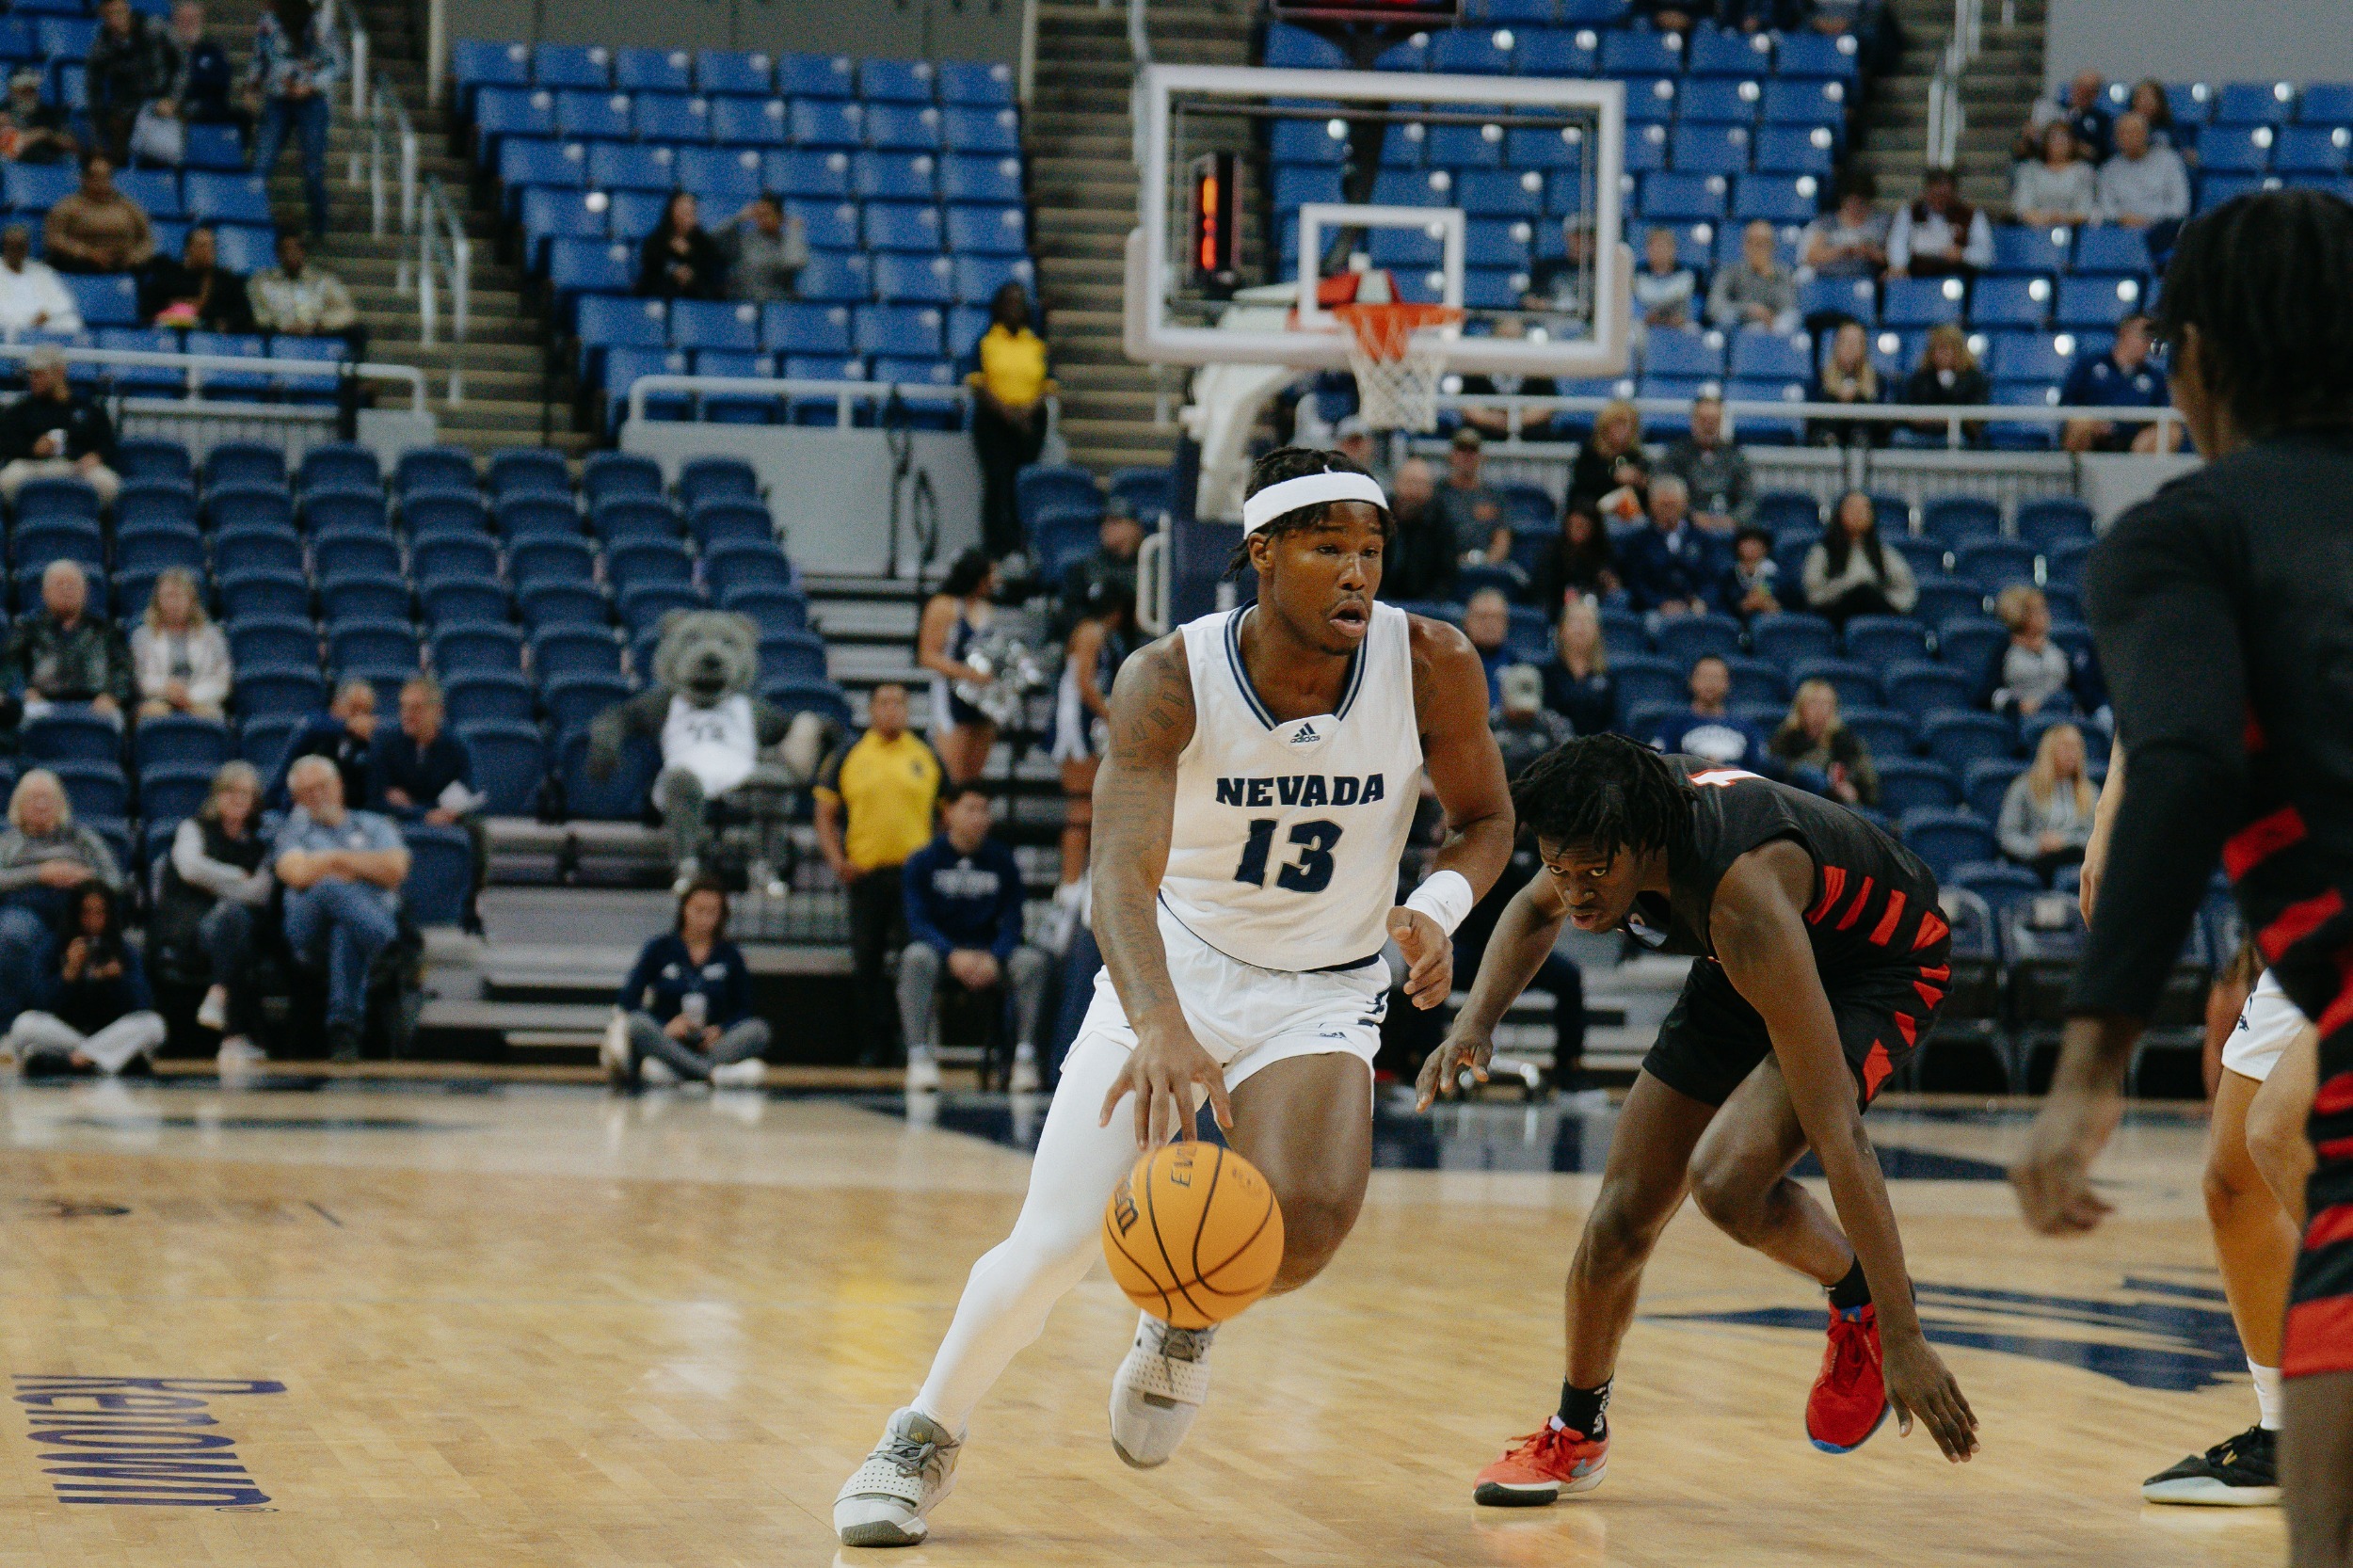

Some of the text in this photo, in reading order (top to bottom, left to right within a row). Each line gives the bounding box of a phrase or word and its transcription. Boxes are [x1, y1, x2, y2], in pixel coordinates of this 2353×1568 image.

[1289, 733, 1321, 744] adidas
[1215, 773, 1385, 808] NEVADA
[1232, 817, 1345, 894] 13
